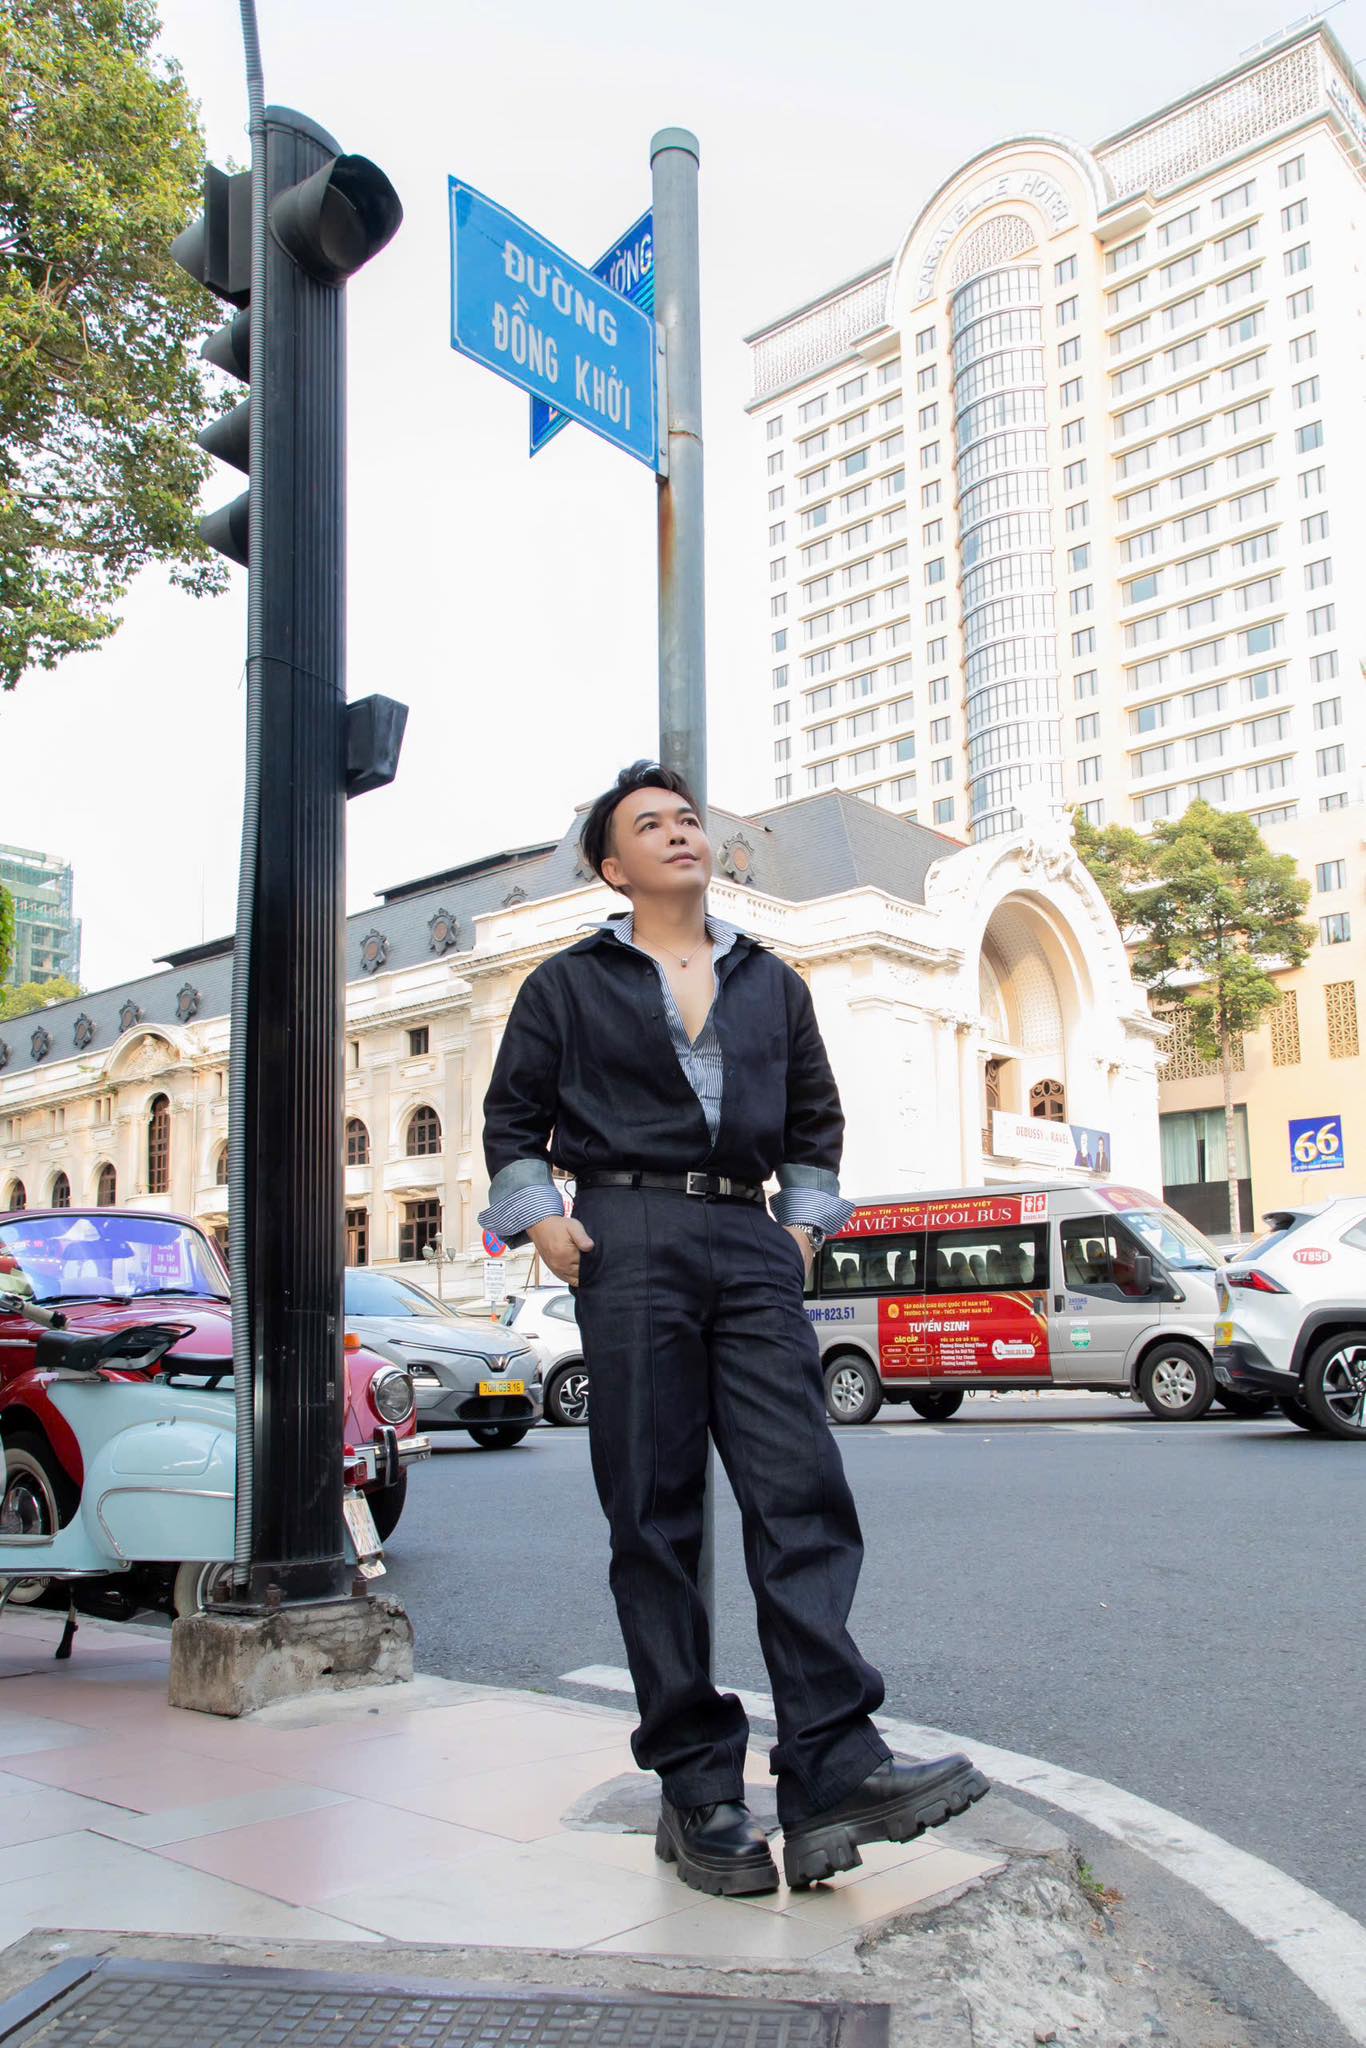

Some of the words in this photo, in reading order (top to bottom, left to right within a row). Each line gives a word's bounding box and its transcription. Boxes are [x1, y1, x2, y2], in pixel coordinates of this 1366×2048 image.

[603, 233, 652, 294] ƯỜNG
[502, 240, 617, 346] ĐƯỜNG
[492, 294, 559, 384] ĐỒNG
[575, 354, 631, 431] KHỞI
[1294, 1122, 1339, 1163] 66
[864, 1215, 900, 1231] VIỆT
[902, 1210, 974, 1228] SCHOOL
[977, 1207, 1012, 1222] BUS
[943, 1321, 970, 1332] SINH
